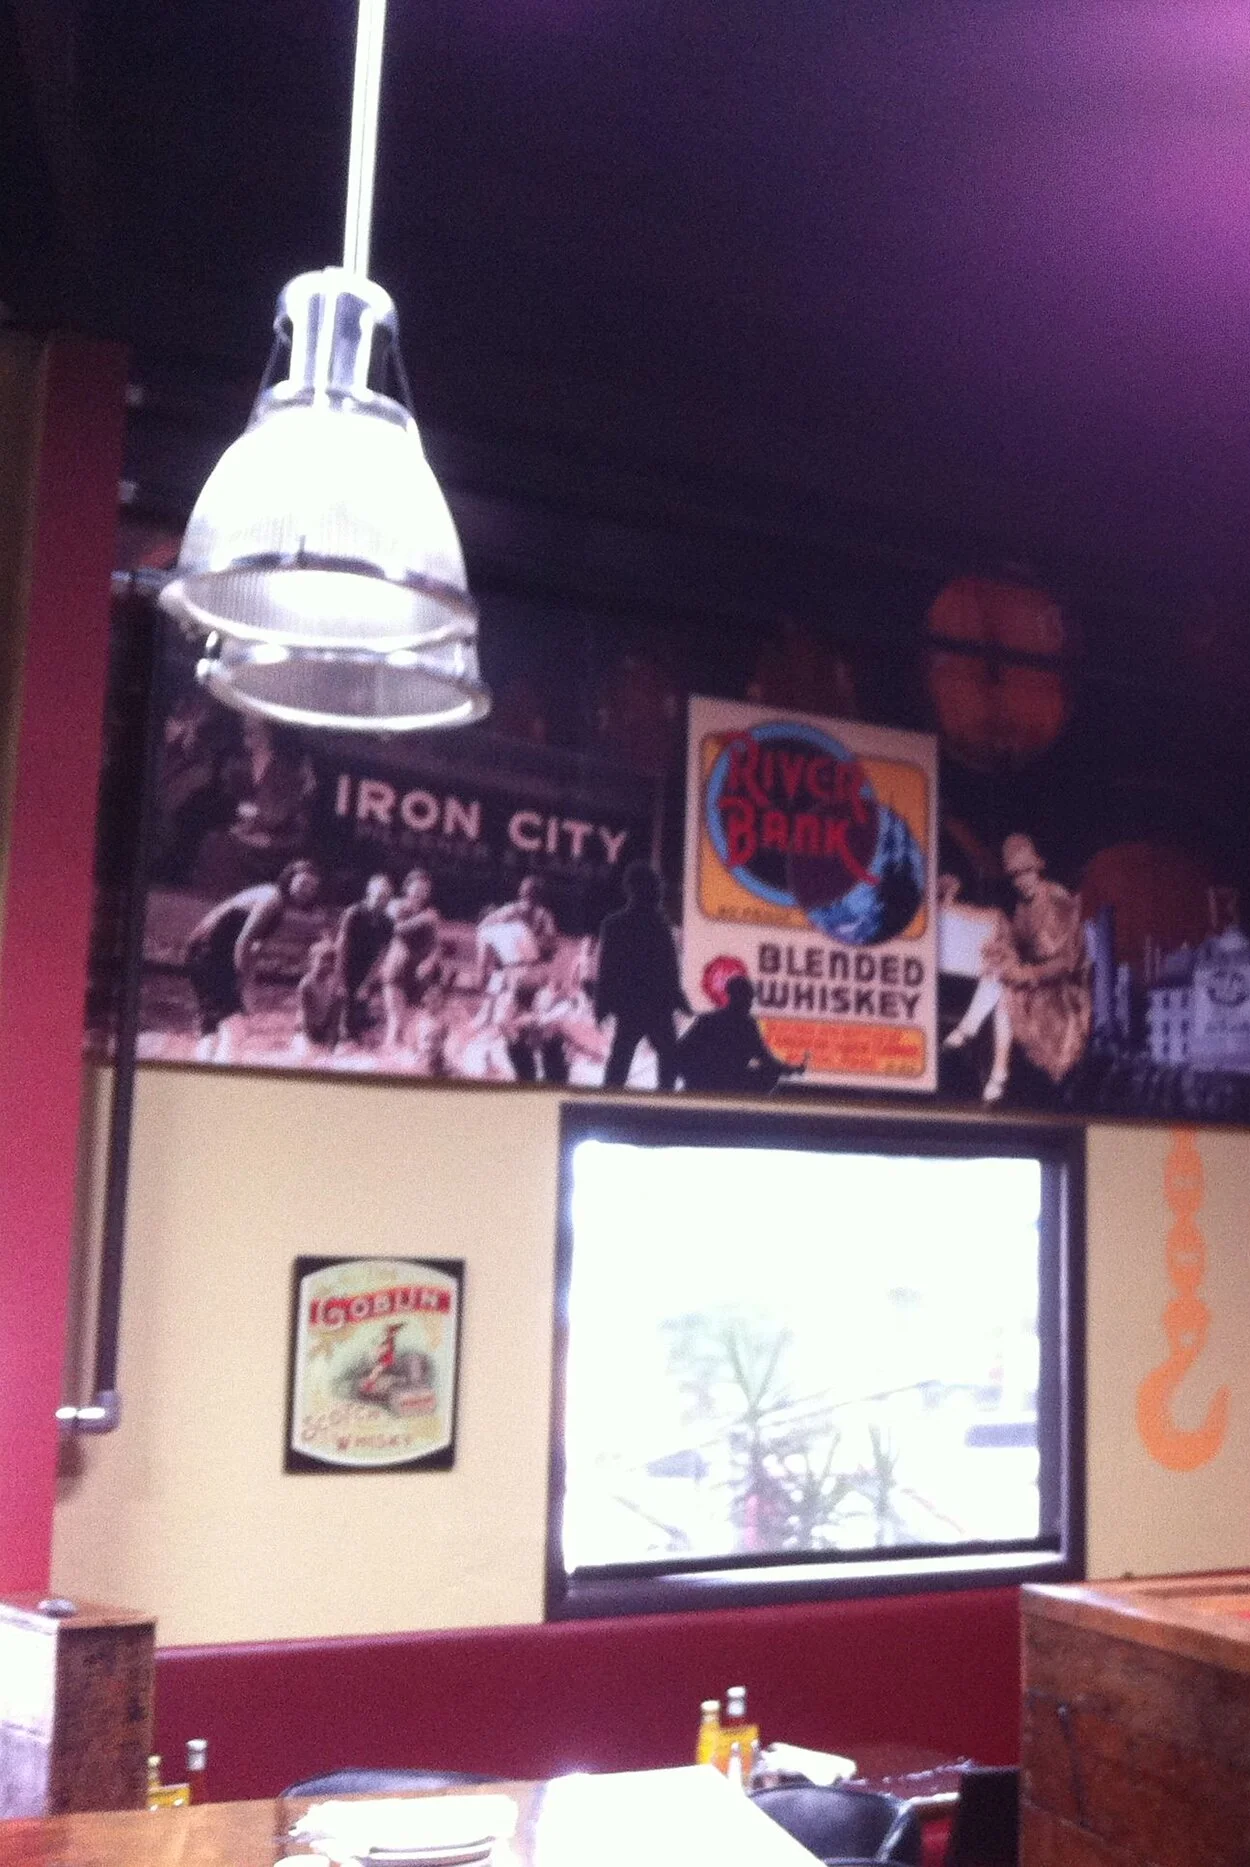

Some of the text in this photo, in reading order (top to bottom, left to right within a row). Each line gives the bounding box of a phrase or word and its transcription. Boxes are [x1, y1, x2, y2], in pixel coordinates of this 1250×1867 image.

[718, 731, 868, 824] RIVER
[335, 773, 629, 864] IRON CITY
[718, 794, 880, 885] BANK
[755, 979, 923, 1020] WHISKEY
[757, 943, 925, 988] BLENDED
[317, 1287, 440, 1331] GOBLIN
